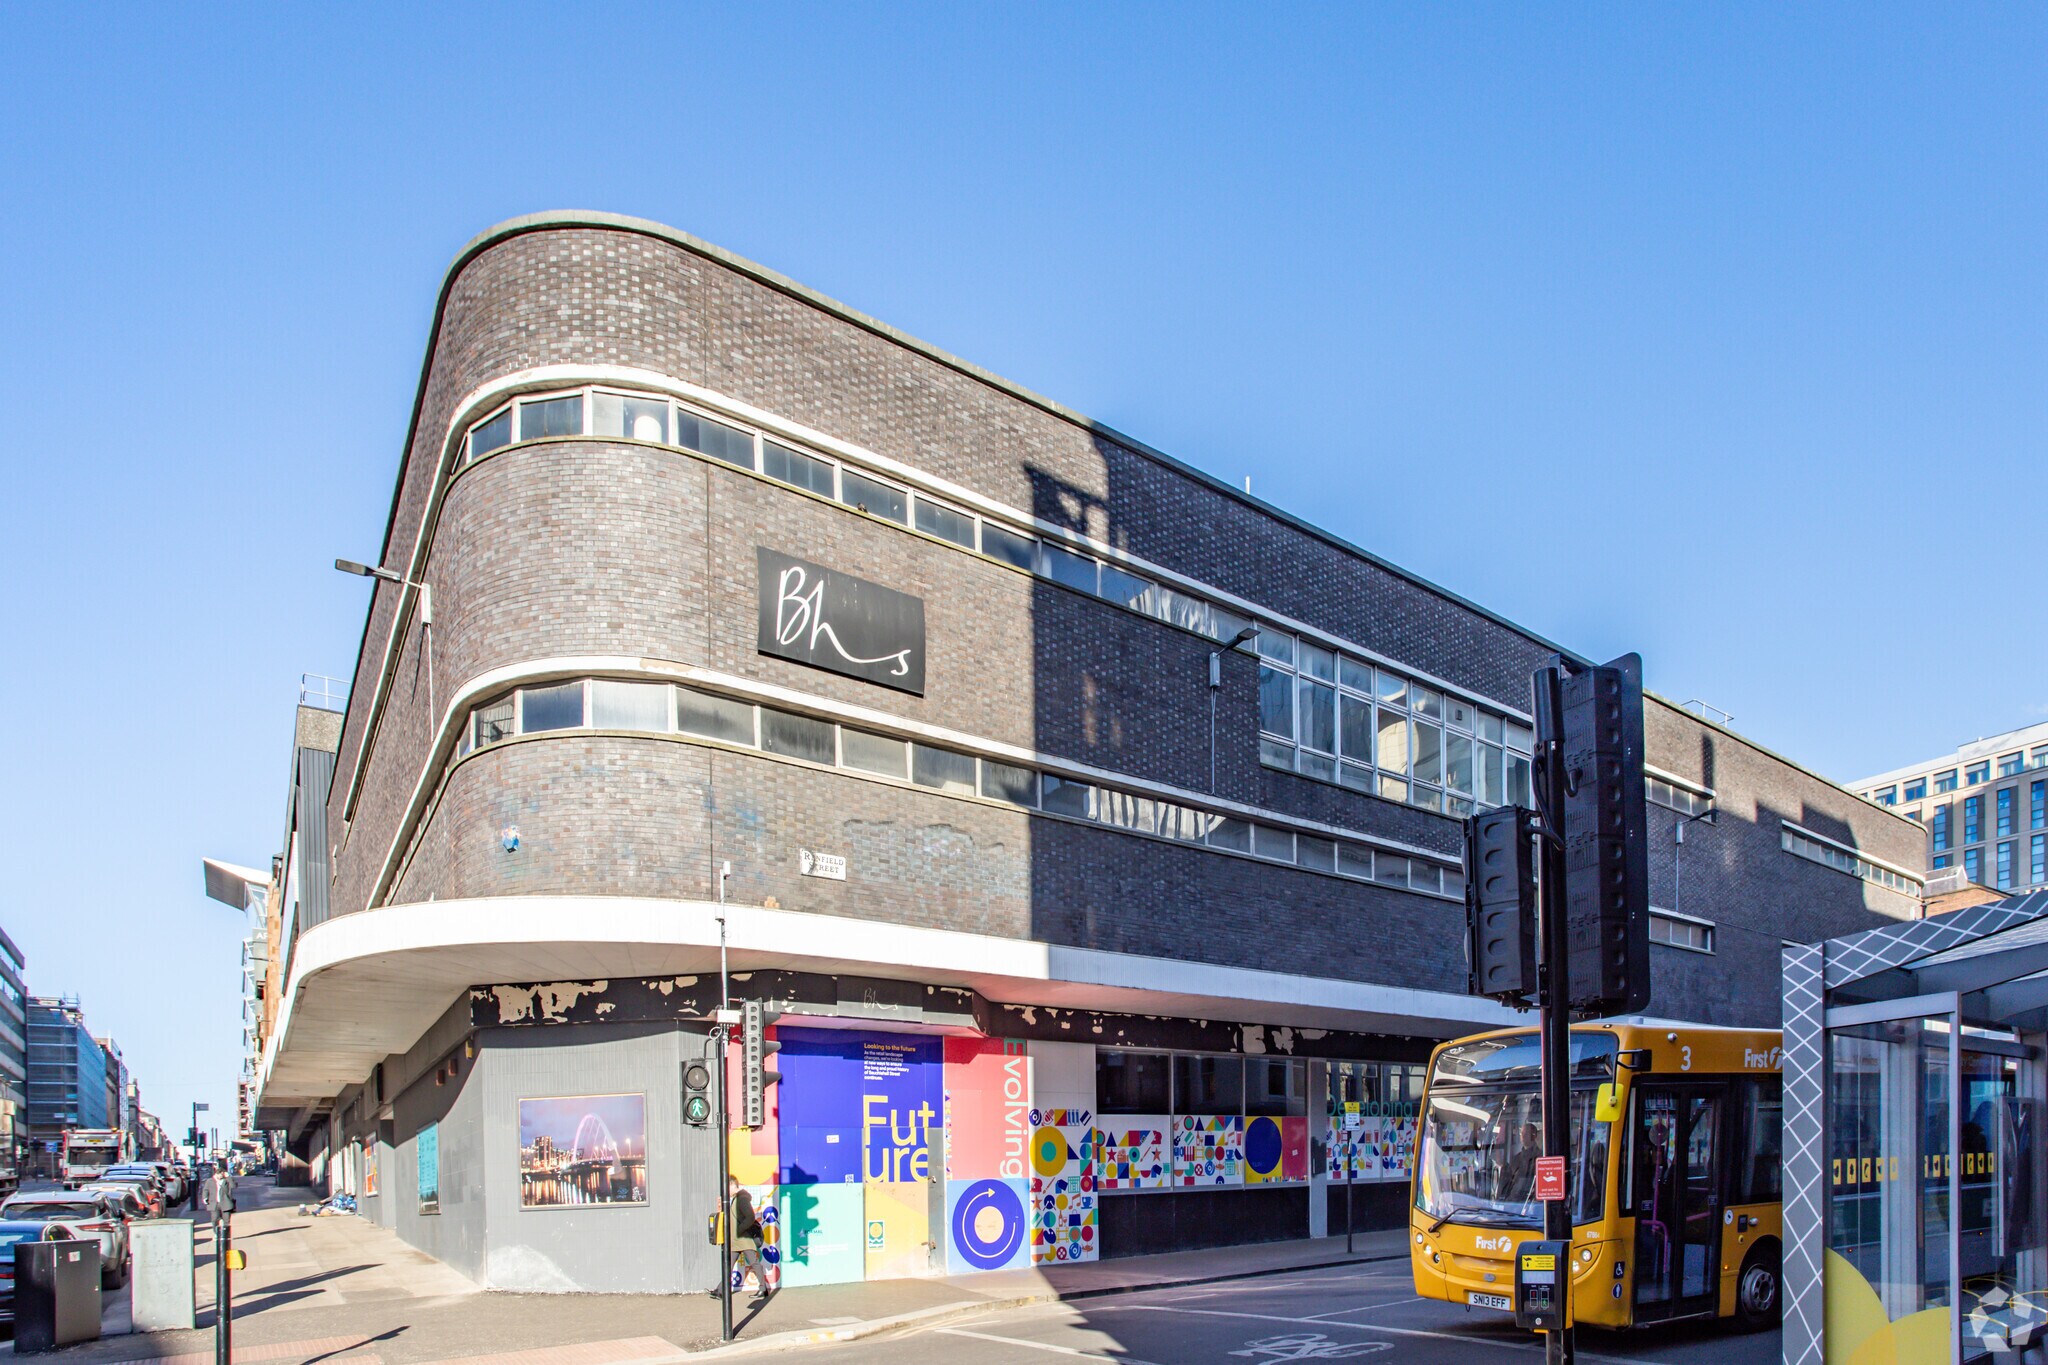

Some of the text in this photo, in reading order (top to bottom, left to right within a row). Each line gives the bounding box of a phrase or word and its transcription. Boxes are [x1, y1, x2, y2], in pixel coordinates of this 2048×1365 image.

[776, 566, 911, 676] Bhs
[804, 851, 844, 866] RNFIELD
[864, 1043, 885, 1051] Looking
[1680, 1045, 1692, 1071] 3
[1744, 1048, 1768, 1069] First
[999, 1038, 1028, 1179] Evolving
[863, 1094, 935, 1147] Fut
[865, 1147, 929, 1184] ure
[1475, 1236, 1497, 1250] First
[1473, 1294, 1506, 1307] SN13 EFF
